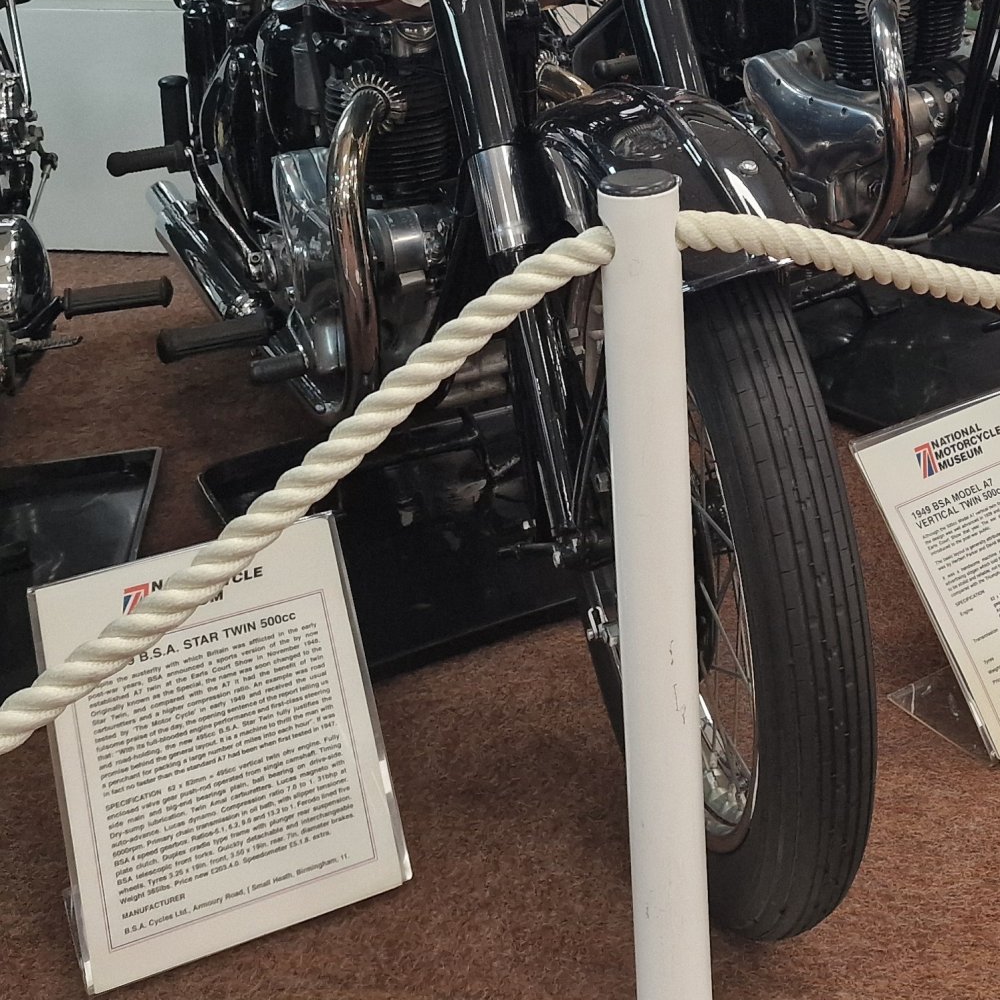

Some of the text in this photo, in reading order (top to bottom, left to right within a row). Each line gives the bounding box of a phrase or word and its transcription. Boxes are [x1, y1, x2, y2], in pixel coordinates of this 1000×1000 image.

[931, 423, 982, 450] NATIONAL
[938, 446, 983, 471] MUSEUM
[912, 478, 992, 520] 1949 BSA MODEL A7
[916, 506, 960, 529] VERTICAL
[958, 495, 982, 510] TWIN
[132, 666, 161, 679] austerity
[165, 661, 180, 669] with
[183, 654, 203, 664] which
[207, 647, 229, 658] Britain
[232, 643, 246, 651] was
[301, 623, 317, 631] early
[139, 645, 179, 662] B.S.A.
[184, 633, 218, 649] STAR
[222, 622, 256, 638] TWIN
[261, 613, 296, 628] 500cc
[89, 692, 130, 709] established
[147, 685, 161, 693] twin
[212, 664, 231, 674] Court
[234, 658, 253, 667] Show
[267, 644, 300, 658] November
[167, 662, 205, 678] announced
[216, 654, 238, 664] sports
[241, 646, 266, 656] version
[91, 704, 124, 718] Originally
[127, 697, 150, 707] known
[205, 677, 217, 685] the
[219, 672, 237, 681] name
[239, 667, 253, 675] was
[273, 652, 301, 665] changed
[92, 718, 107, 727] Star
[133, 706, 147, 715] and
[150, 695, 185, 710] compared
[189, 690, 203, 698] with
[243, 674, 256, 682] had
[274, 662, 296, 674] benefit
[310, 655, 324, 663] twin
[95, 733, 117, 744] tested
[151, 717, 172, 727] Motor
[210, 701, 226, 710] early
[249, 690, 262, 698] and
[265, 680, 293, 694] received
[310, 670, 327, 680] usual
[139, 713, 153, 722] and
[162, 704, 184, 715] higher
[187, 691, 231, 708] compression
[265, 673, 293, 685] example
[295, 668, 308, 676] was
[311, 662, 325, 671] road
[122, 893, 185, 920] MANUFACTURER
[149, 914, 173, 927] Cycles
